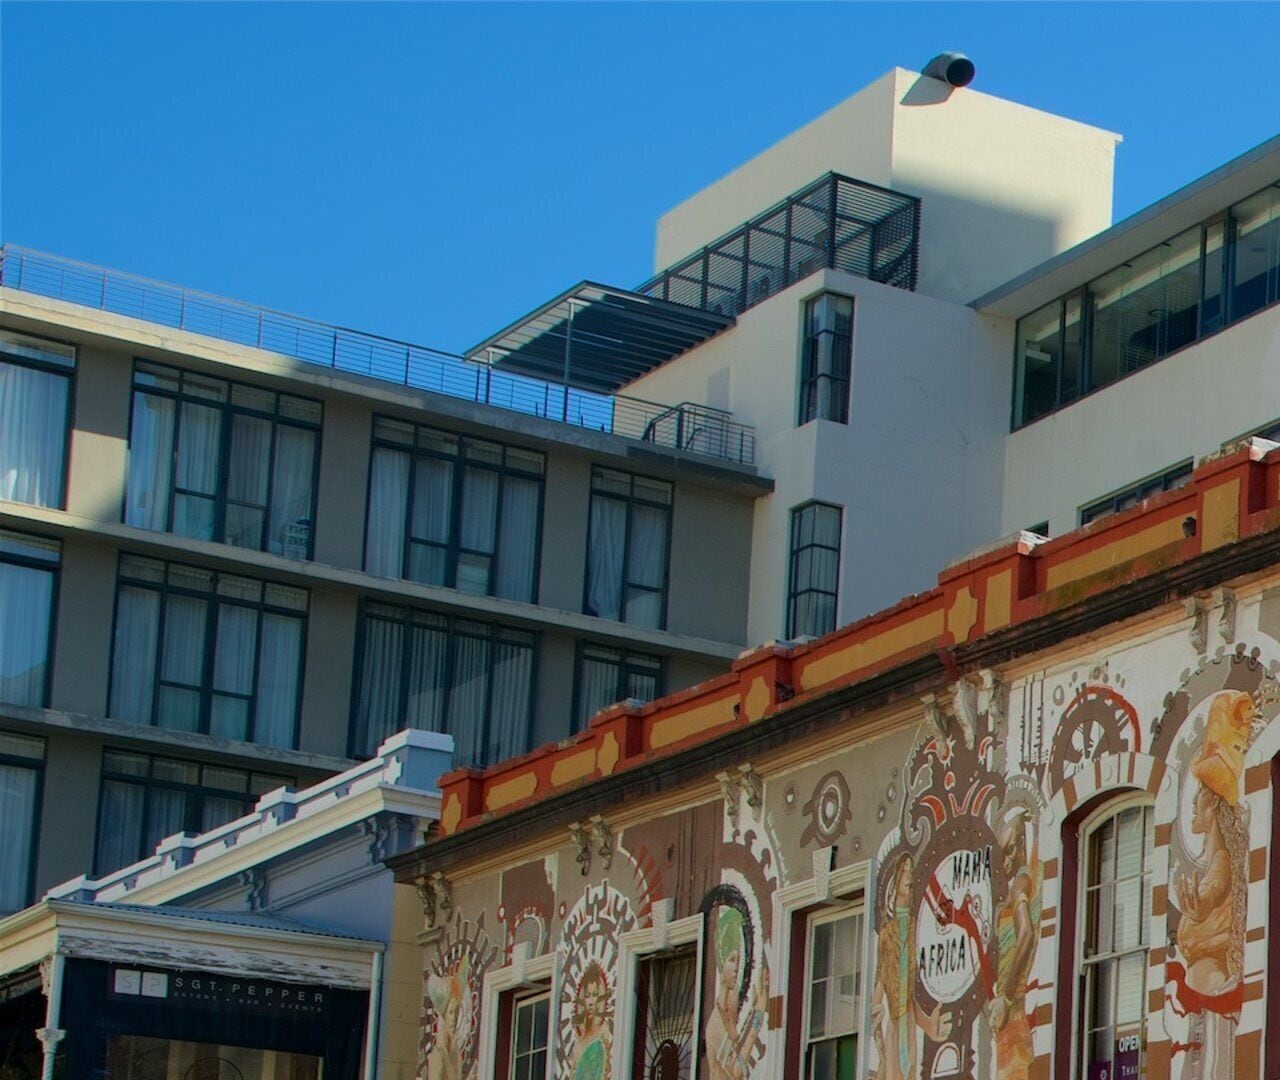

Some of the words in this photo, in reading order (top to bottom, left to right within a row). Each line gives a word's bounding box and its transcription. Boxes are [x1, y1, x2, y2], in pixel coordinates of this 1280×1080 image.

[952, 844, 992, 890] MAMA
[919, 934, 965, 980] AFRICA
[174, 976, 223, 992] SGT.
[231, 983, 324, 1003] PEPPER
